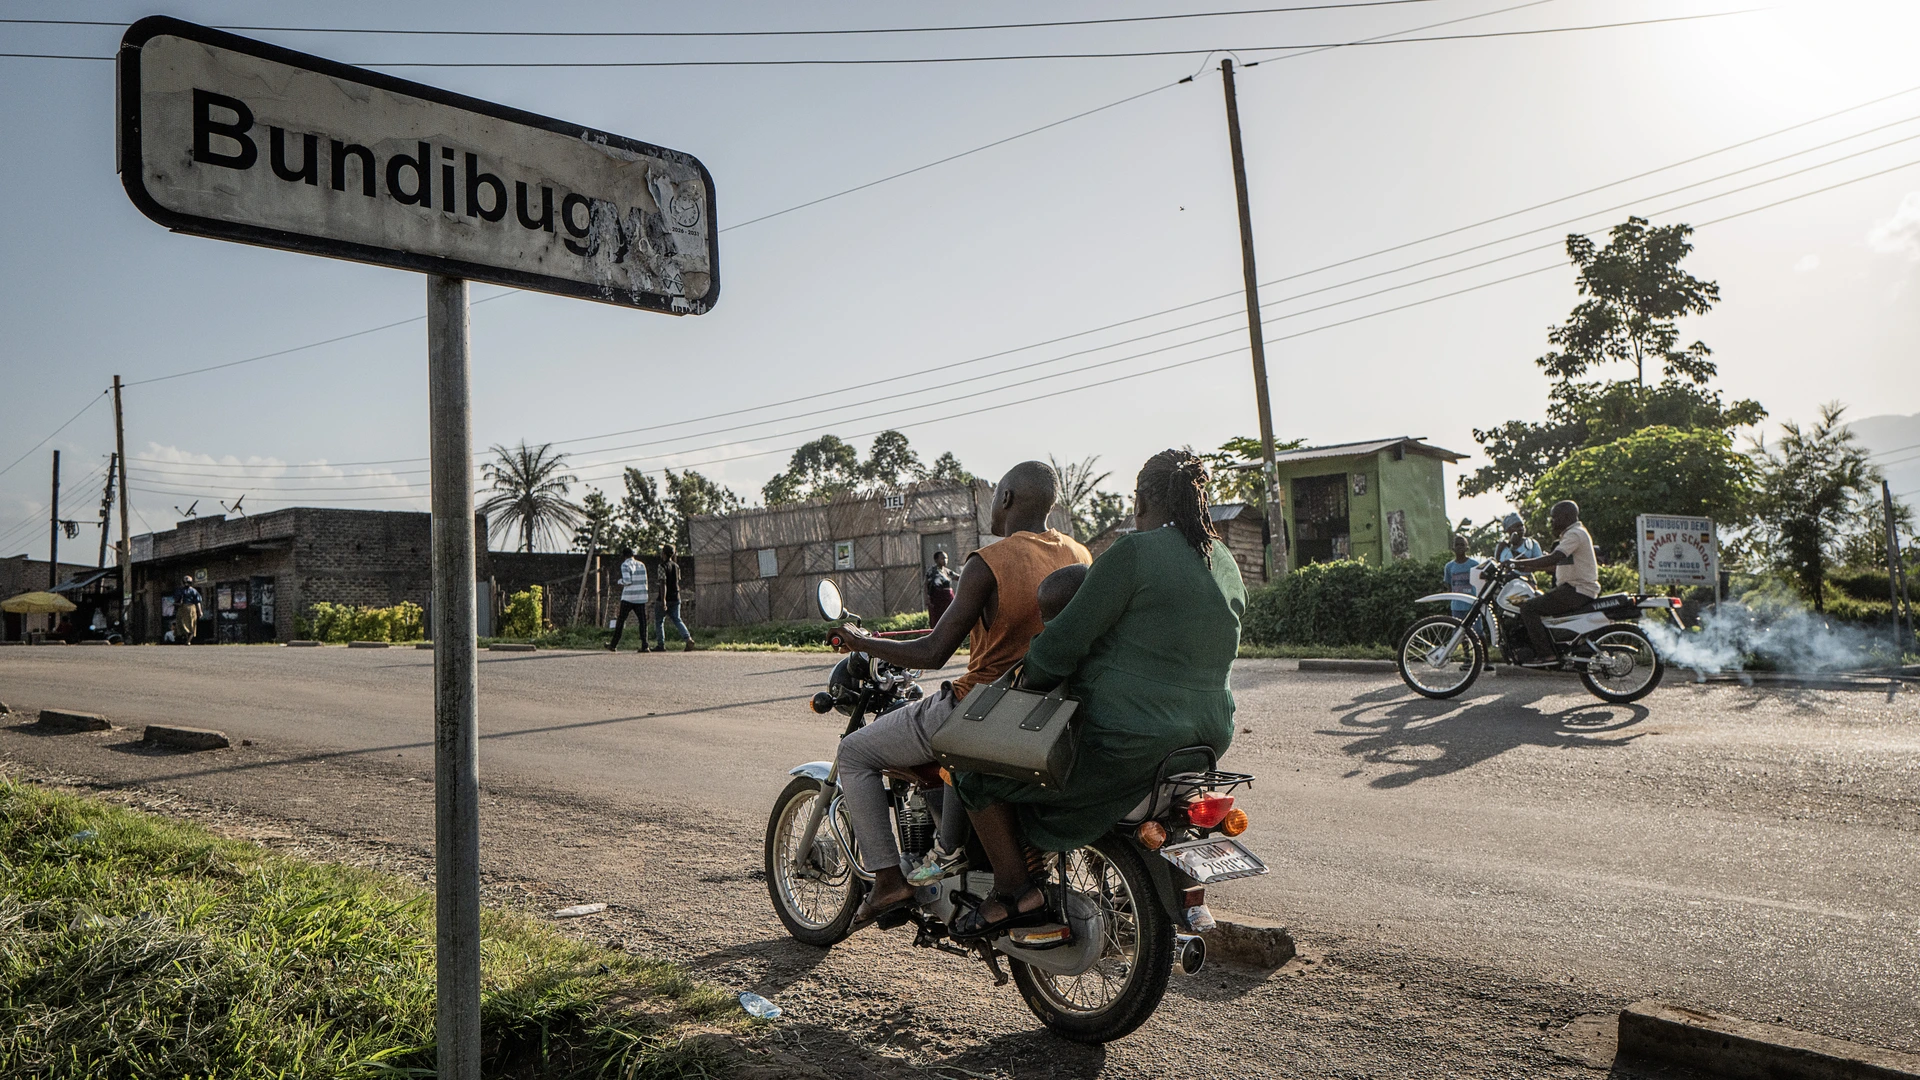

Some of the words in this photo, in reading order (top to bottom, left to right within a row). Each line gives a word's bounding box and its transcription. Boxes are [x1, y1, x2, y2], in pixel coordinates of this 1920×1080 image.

[1648, 532, 1677, 569] PRIMARY
[1681, 533, 1711, 571] SCHOOL
[1592, 599, 1620, 610] YAMAHA
